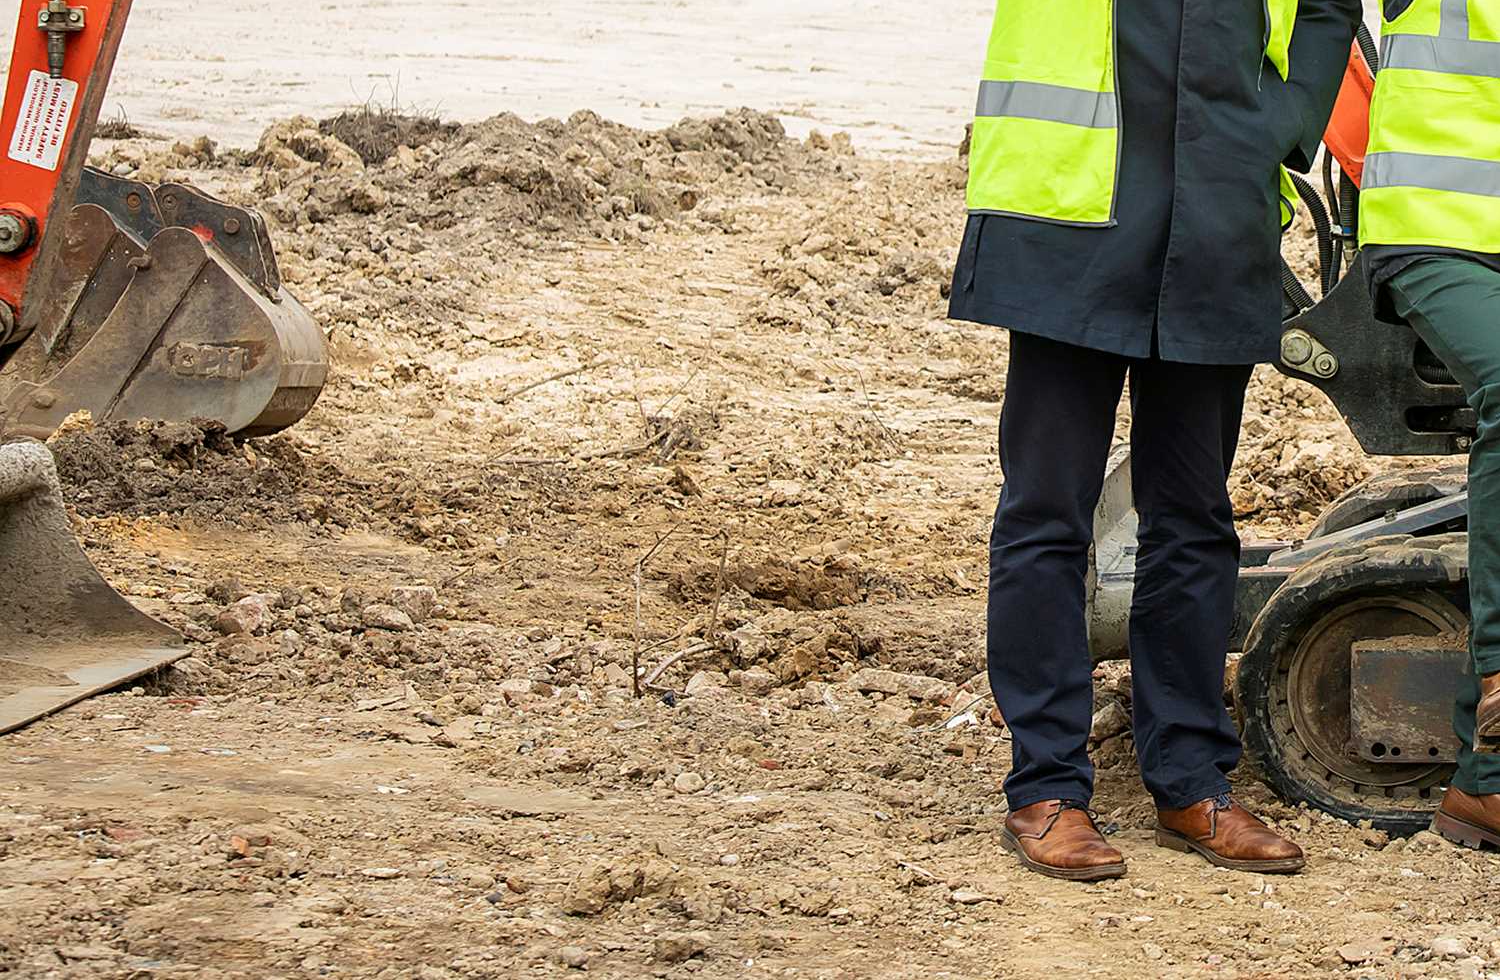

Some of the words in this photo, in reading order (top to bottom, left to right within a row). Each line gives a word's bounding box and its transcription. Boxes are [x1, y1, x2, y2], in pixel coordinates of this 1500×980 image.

[26, 124, 37, 152] MANUAL
[36, 125, 50, 159] SAFETY
[45, 108, 55, 125] PIN
[50, 81, 62, 107] MUST
[51, 133, 59, 146] BE
[55, 100, 68, 132] FITTED
